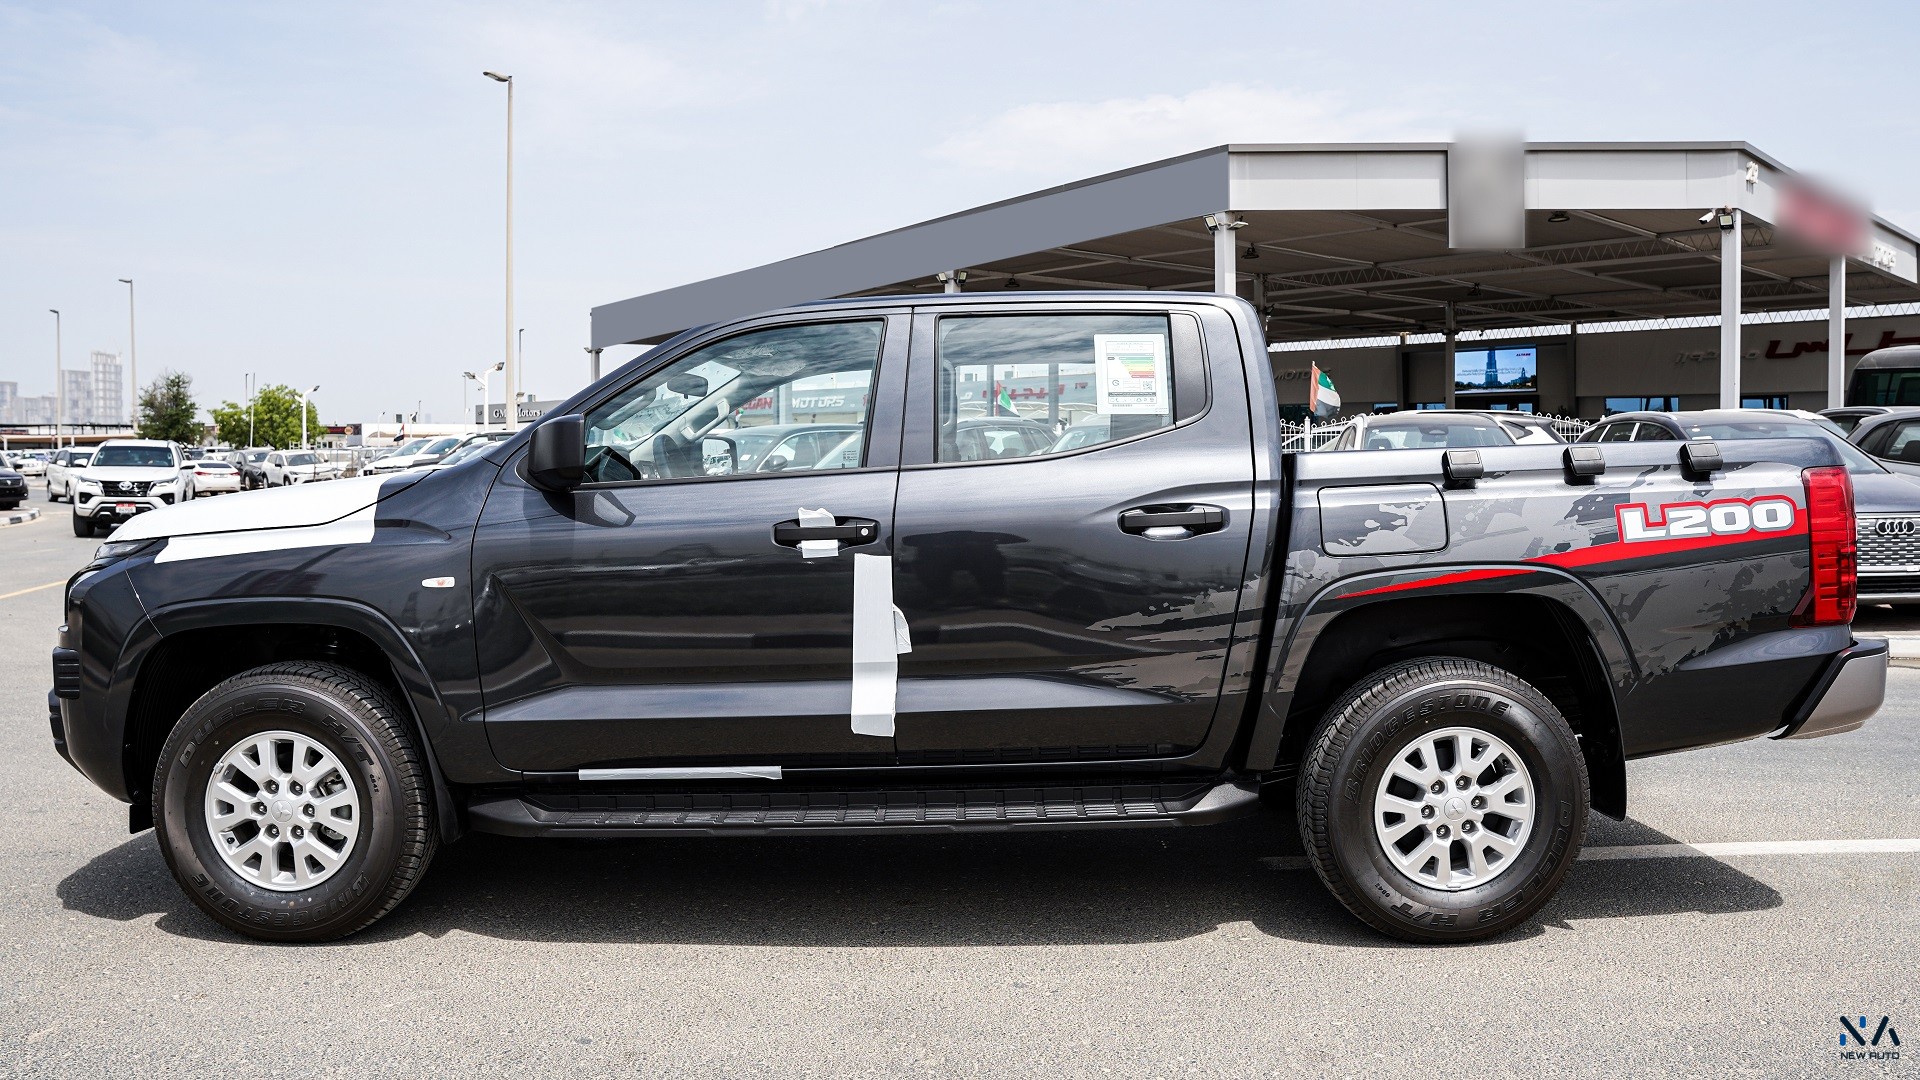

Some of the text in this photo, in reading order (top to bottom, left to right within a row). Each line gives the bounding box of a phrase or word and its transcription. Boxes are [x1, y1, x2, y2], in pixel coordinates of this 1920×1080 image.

[792, 395, 846, 409] MOTORS
[1622, 501, 1794, 541] L200
[178, 697, 306, 767] DUELER
[322, 714, 374, 766] H/T
[1343, 693, 1511, 805] BRIDGESTONE
[1478, 799, 1571, 923] DUELER
[191, 870, 373, 928] BRIDGESTONE
[1390, 901, 1462, 928] H/T
